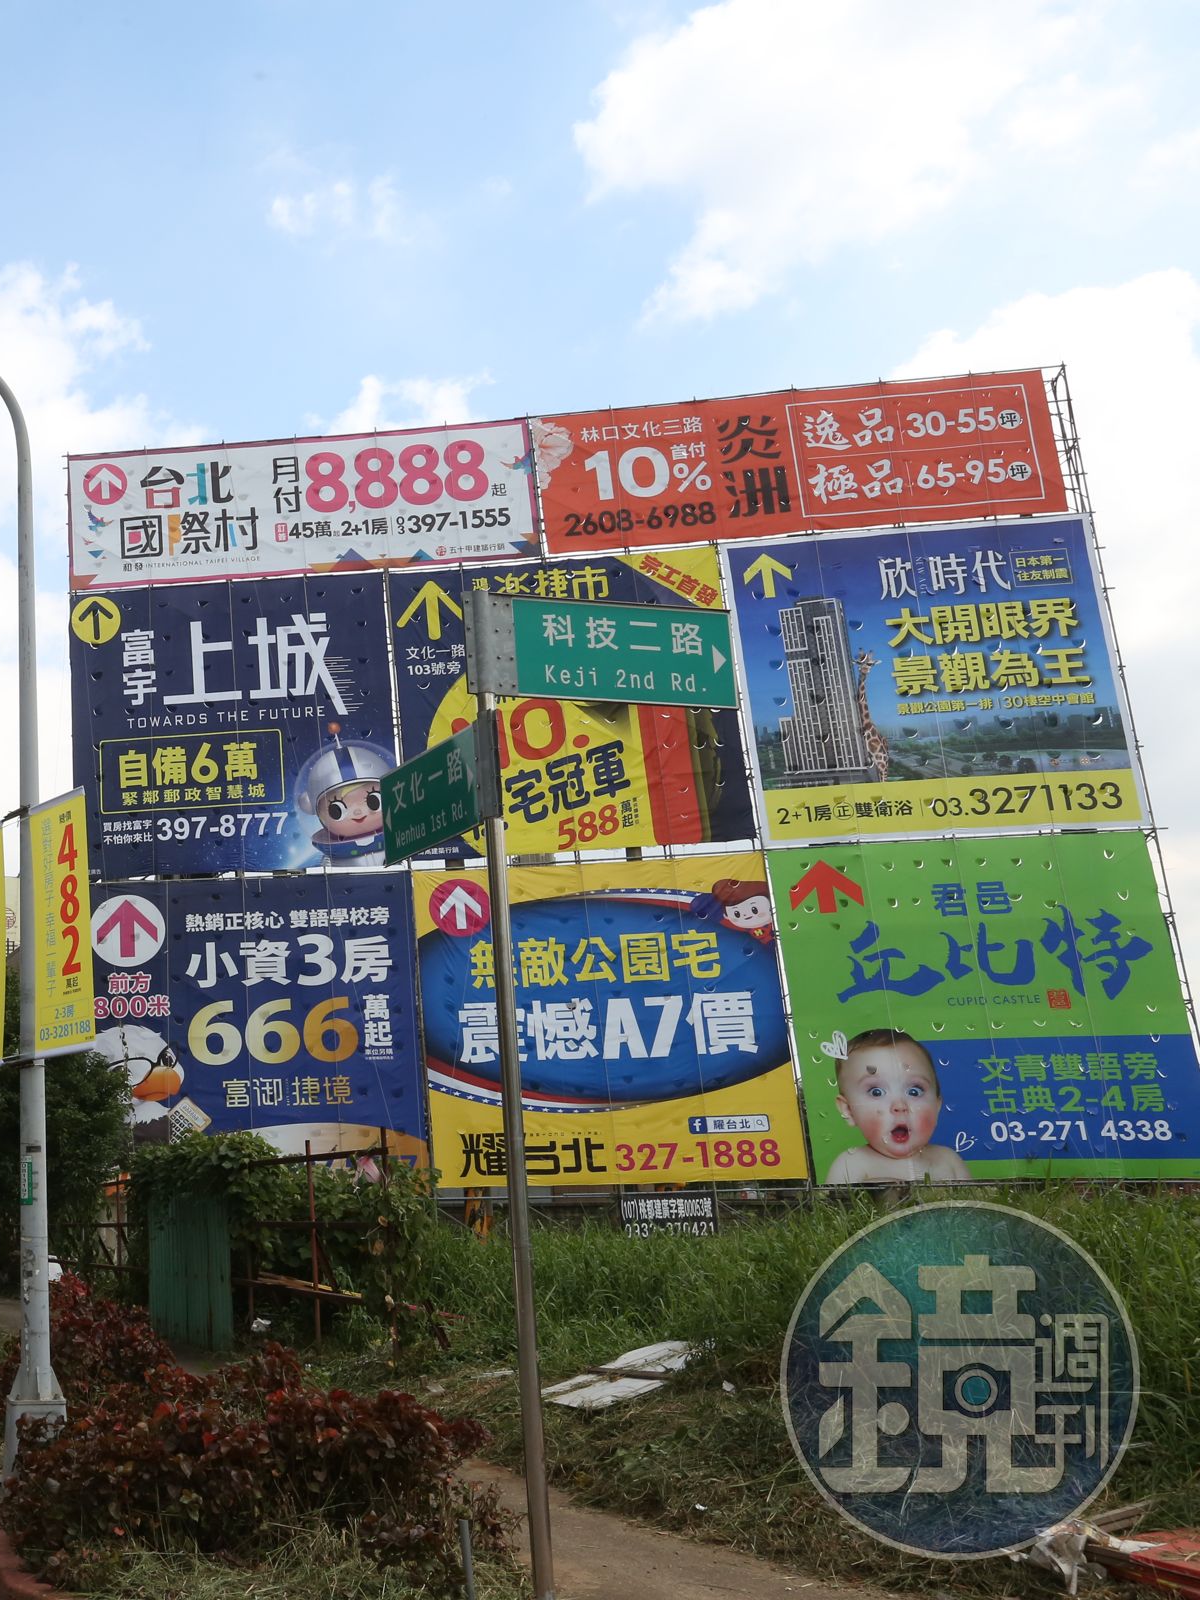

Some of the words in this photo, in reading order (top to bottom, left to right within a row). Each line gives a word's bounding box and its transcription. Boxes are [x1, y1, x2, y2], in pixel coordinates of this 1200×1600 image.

[580, 416, 703, 442] 林口文化三路
[801, 407, 895, 453] 逸品
[671, 441, 707, 460] 首付
[716, 414, 792, 520] 炎洲
[807, 458, 904, 505] 極品
[139, 460, 234, 511] 台北
[273, 456, 302, 516] 月付
[490, 482, 509, 498] 起
[288, 520, 332, 539] 45萬
[341, 516, 390, 537] 2+1房
[407, 507, 512, 535] 397-1555
[564, 501, 717, 537] 2608-6988
[119, 510, 261, 561] 國際村
[145, 559, 203, 569] INTERNATIONAL
[205, 557, 229, 565] TAIPEI
[231, 555, 261, 564] VILLAGE
[878, 550, 1012, 600] 欣時代
[1015, 555, 1064, 568] 日本第一
[542, 613, 703, 656] 科技二路
[885, 597, 1080, 648] 大開眼界
[120, 628, 157, 706] 富宇
[163, 612, 349, 716] 上城
[406, 644, 465, 662] 文化一路
[406, 661, 461, 676] 103號旁
[545, 664, 598, 688] Keji
[616, 669, 655, 690] 2nd
[671, 675, 708, 693] Rd.
[891, 647, 1092, 696] 景觀為王
[896, 701, 993, 716] 景觀公園第一排
[1003, 692, 1095, 710] 30樓空中會館
[127, 713, 208, 729] TOWARDS
[217, 710, 249, 723] THE
[258, 705, 326, 721] FUTURE
[118, 741, 258, 789] 自備6萬
[121, 783, 266, 806] 緊鄰郵政智慧城
[392, 748, 464, 815] 文化一路
[103, 820, 153, 832] 買房找富宇
[156, 811, 289, 842] 397-8777
[557, 804, 620, 850] 588
[620, 799, 634, 829] 萬起
[103, 832, 153, 845] 不怕你來比
[395, 822, 427, 848] Wenhua
[57, 823, 81, 976] 482
[931, 882, 1013, 917] 君邑
[185, 912, 285, 933] 熱銷正核心
[289, 906, 390, 928] 雙語學校旁
[185, 933, 393, 989] 小資3房
[836, 904, 1153, 1003] 丘比特
[108, 972, 151, 994] 前方
[94, 996, 170, 1019] 800米
[947, 996, 988, 1006] CUPID
[993, 993, 1040, 1005] CASTLE
[39, 1021, 91, 1041] 03-3281188
[187, 996, 359, 1066] 666
[362, 994, 393, 1048] 萬起
[978, 1052, 1159, 1083] 文青雙語旁
[983, 1083, 1166, 1114] 古典2-4房
[713, 1119, 751, 1130] 耀台北
[991, 1120, 1088, 1142] 03-271
[1101, 1120, 1173, 1140] 4338
[615, 1139, 781, 1171] 327-1888
